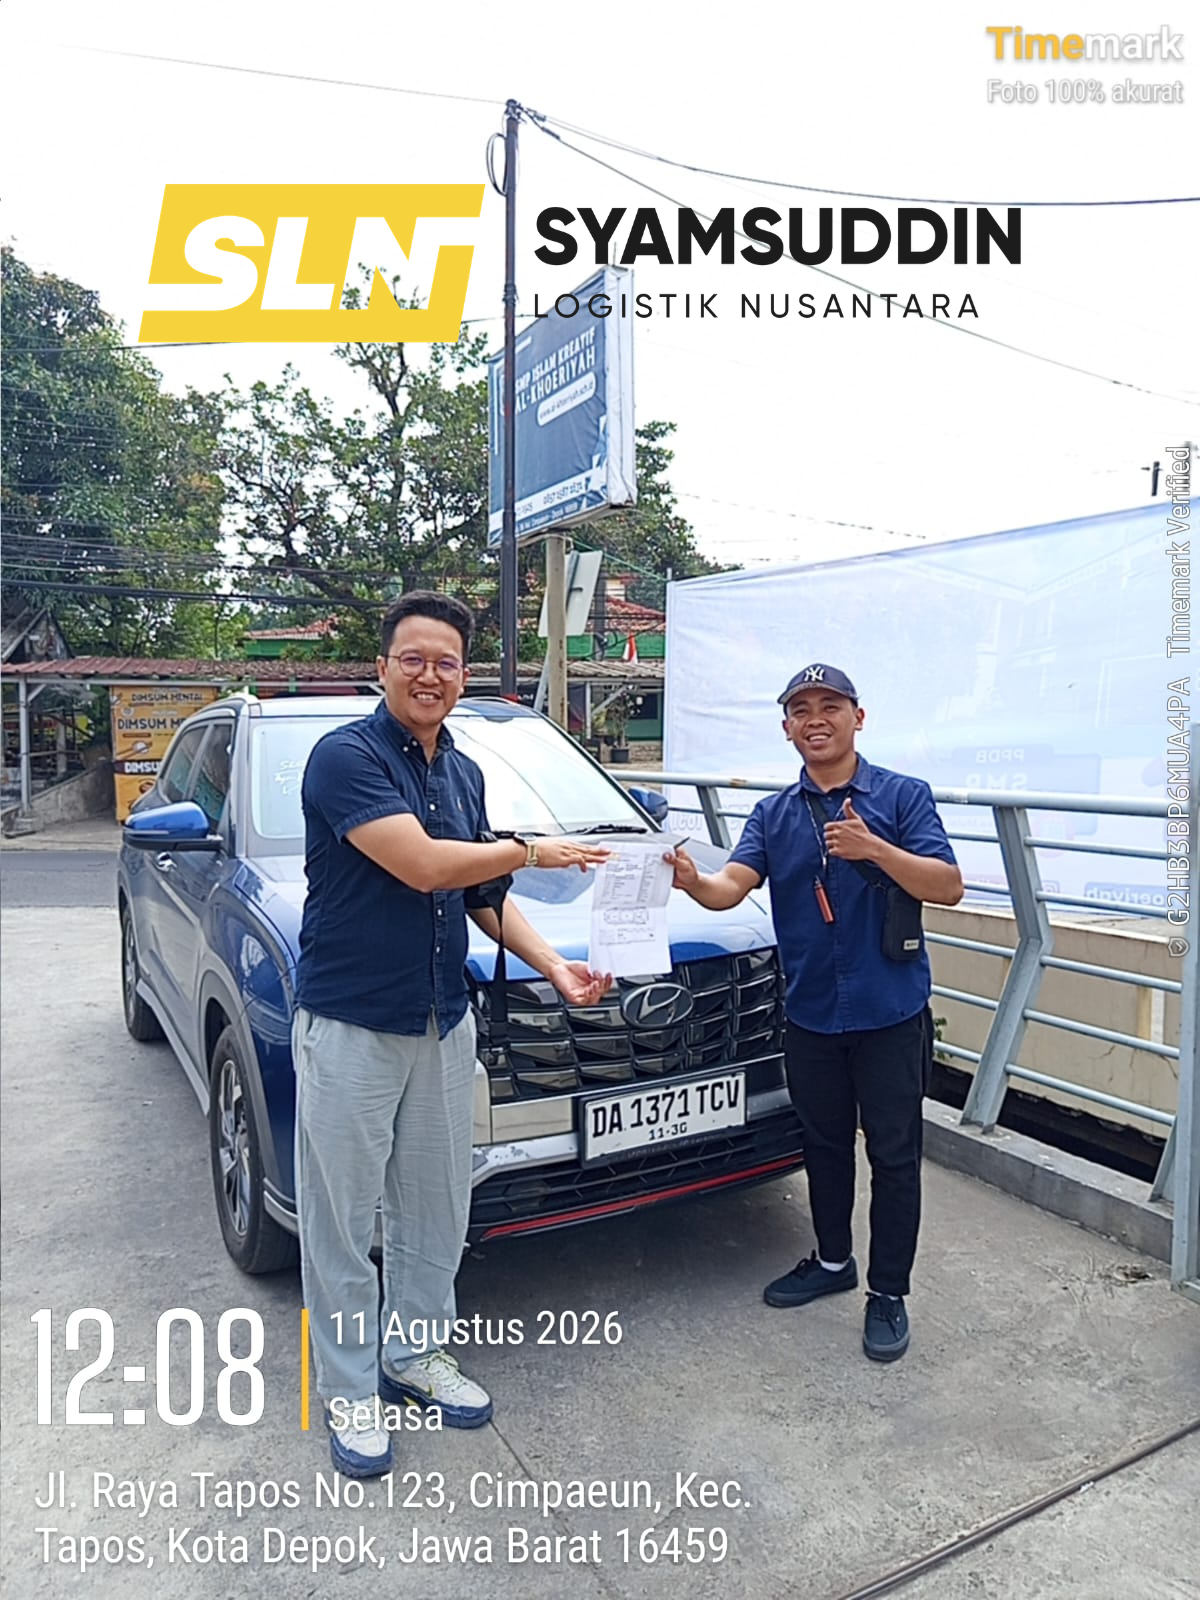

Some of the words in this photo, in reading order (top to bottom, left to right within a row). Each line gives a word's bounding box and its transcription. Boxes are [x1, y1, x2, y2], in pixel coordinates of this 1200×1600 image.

[532, 352, 557, 383] ISLAM
[558, 326, 595, 366] KREATIF
[804, 665, 825, 682] NY
[131, 693, 168, 701] DIMSUM
[117, 718, 167, 729] DIMSUM
[592, 1102, 623, 1138] DA
[630, 1088, 690, 1128] 1371
[696, 1079, 740, 1115] TCV
